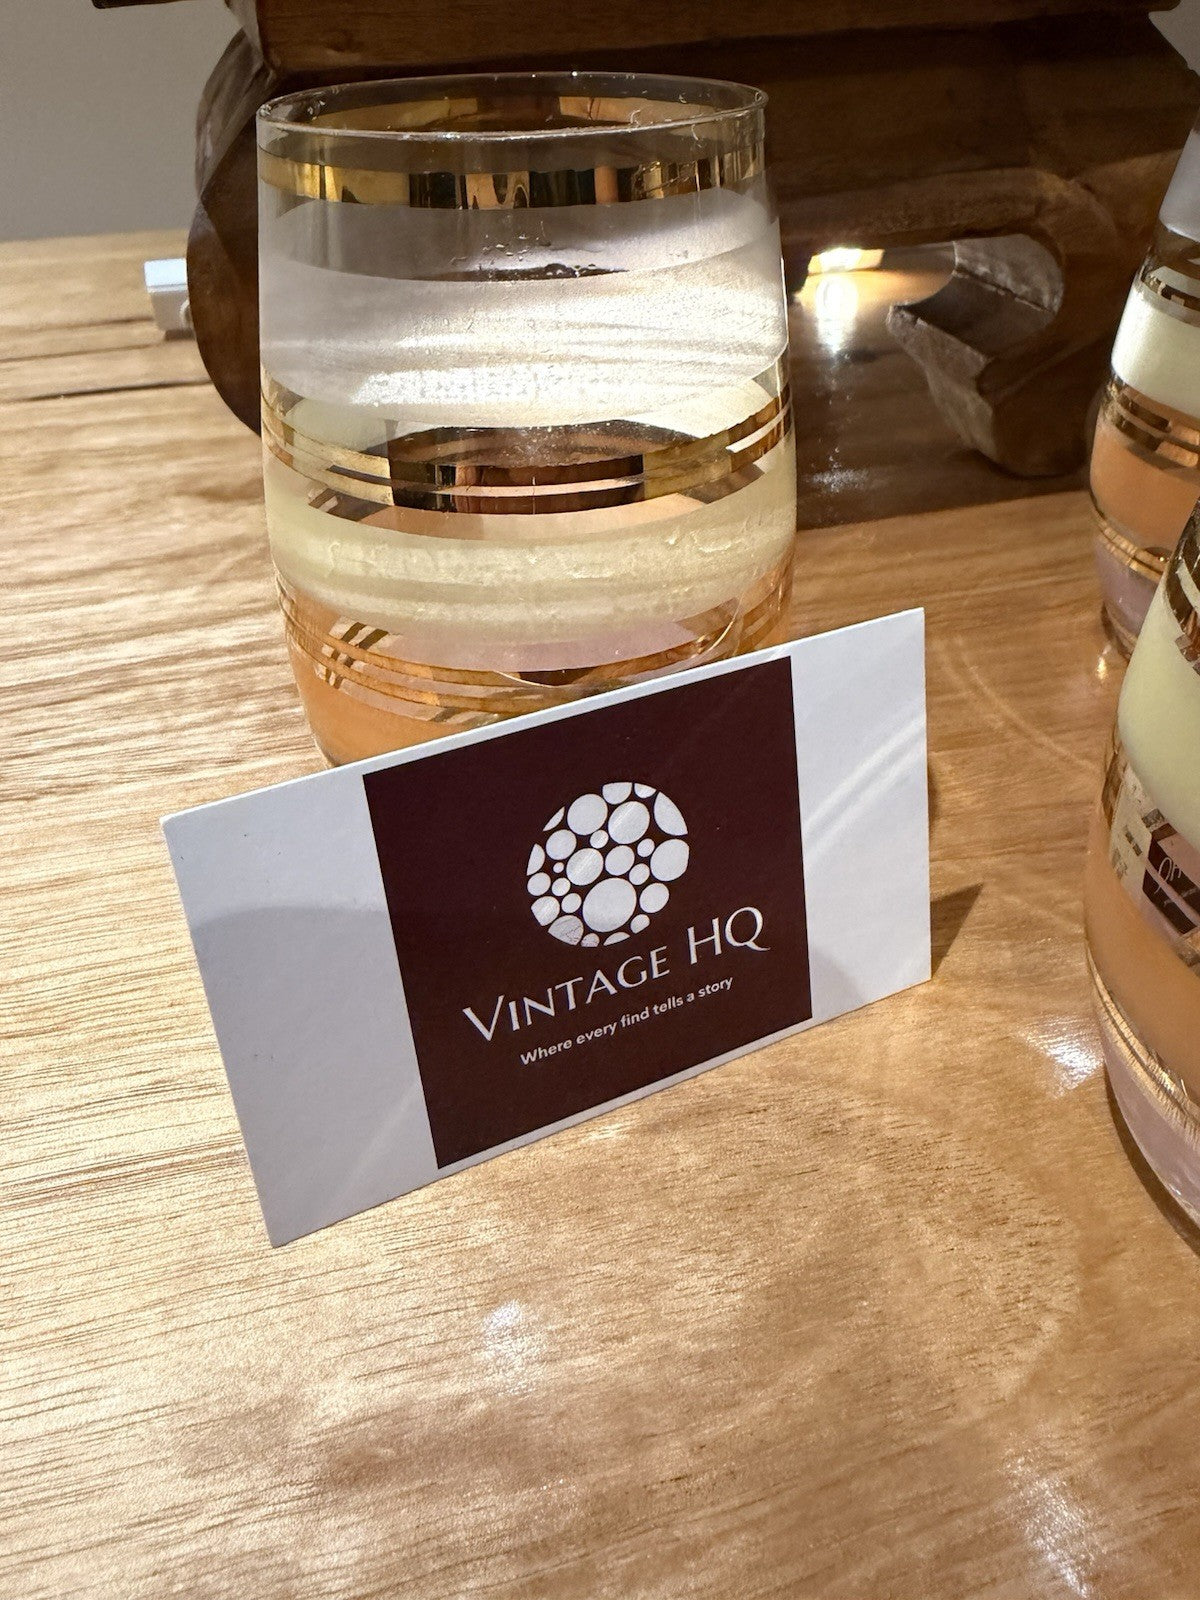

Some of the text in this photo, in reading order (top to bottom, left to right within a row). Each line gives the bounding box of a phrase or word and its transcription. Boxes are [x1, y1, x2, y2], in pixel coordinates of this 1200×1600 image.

[462, 906, 771, 1042] VINTAGE HQ
[520, 976, 733, 1065] Where every find tells a story
